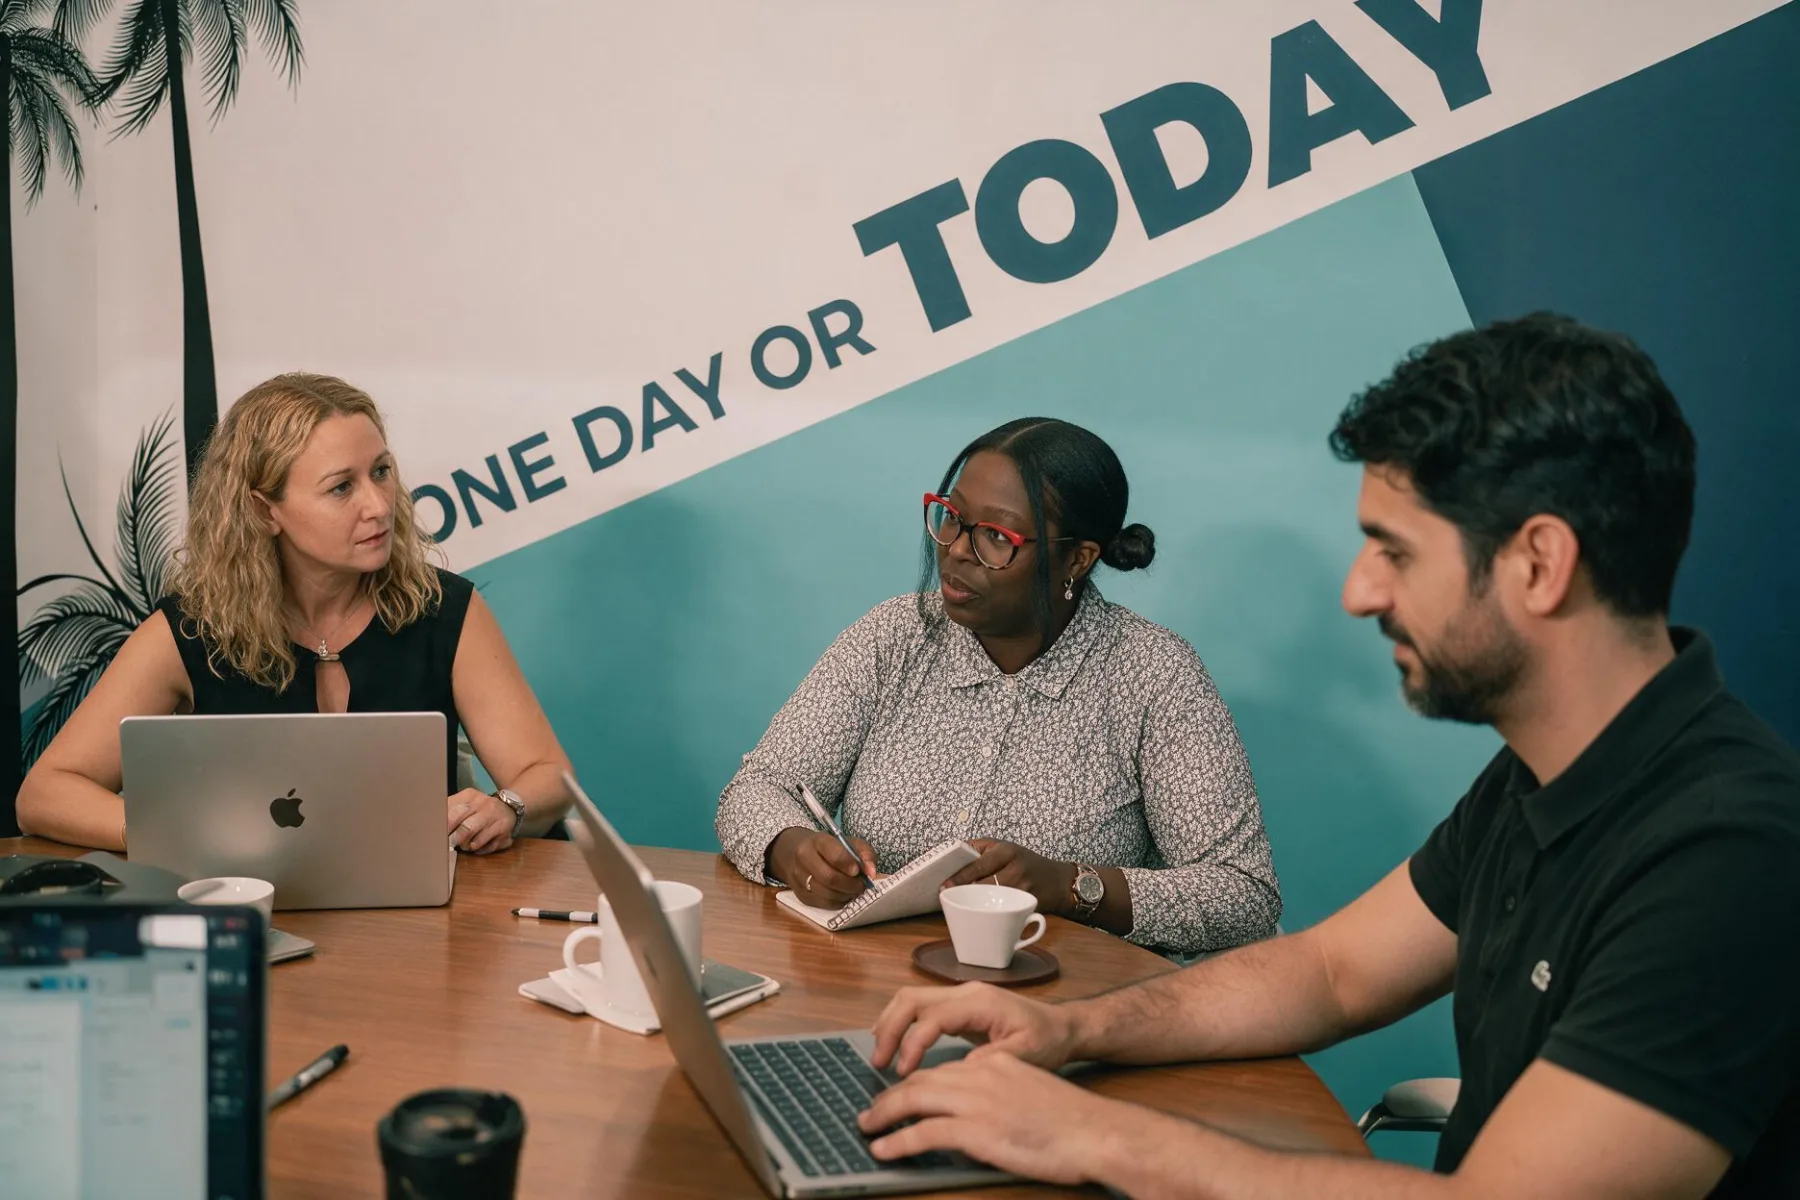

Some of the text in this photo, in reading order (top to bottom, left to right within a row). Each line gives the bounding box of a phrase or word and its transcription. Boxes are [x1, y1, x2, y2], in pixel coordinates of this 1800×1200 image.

[411, 0, 1492, 544] ONE DAY OR TODAY
